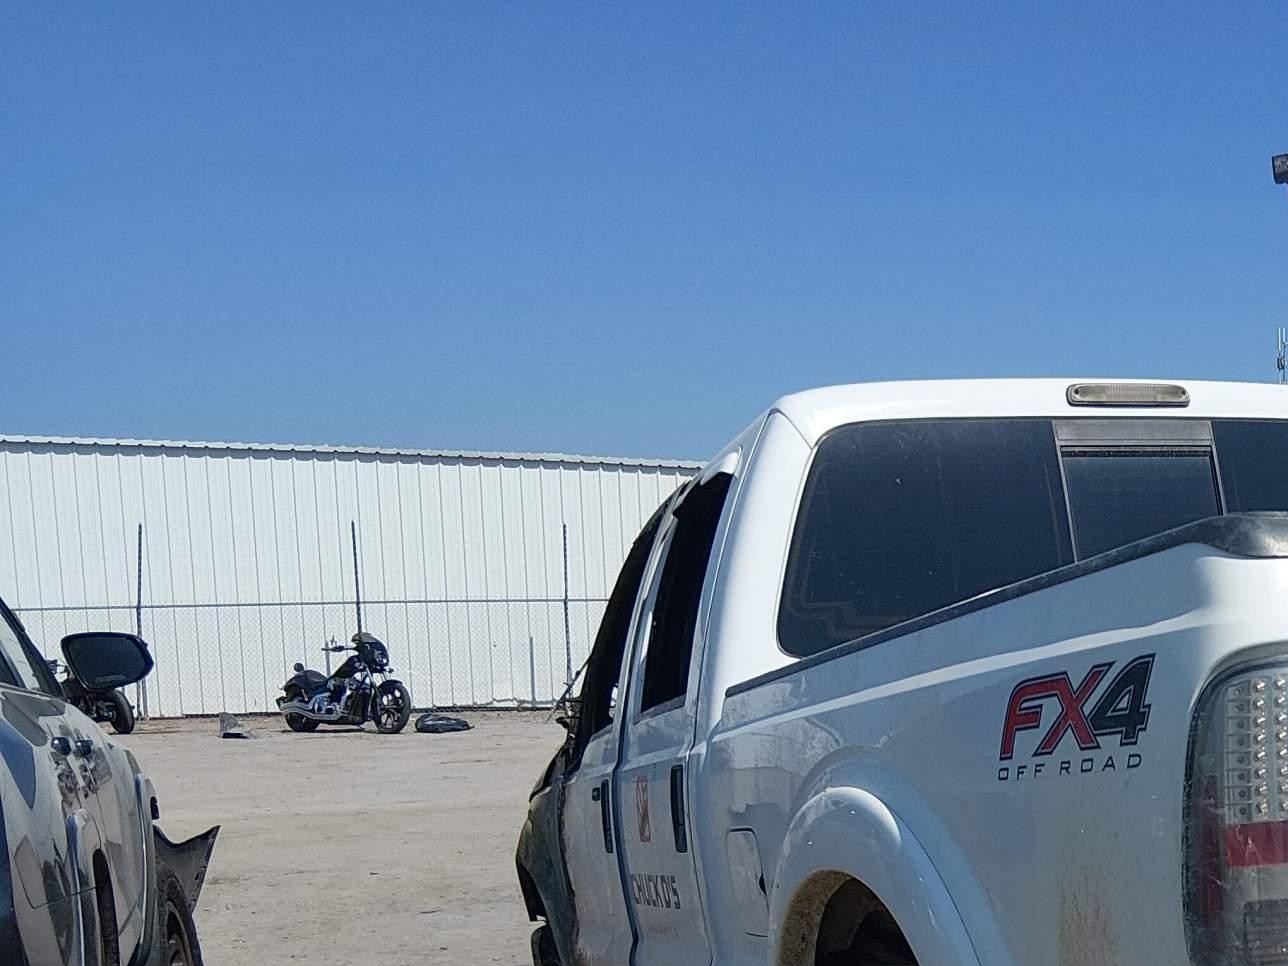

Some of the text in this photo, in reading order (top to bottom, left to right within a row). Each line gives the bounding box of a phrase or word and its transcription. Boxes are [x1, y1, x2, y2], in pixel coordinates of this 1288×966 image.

[999, 653, 1156, 761] FX4
[998, 754, 1142, 781] OFF ROAD
